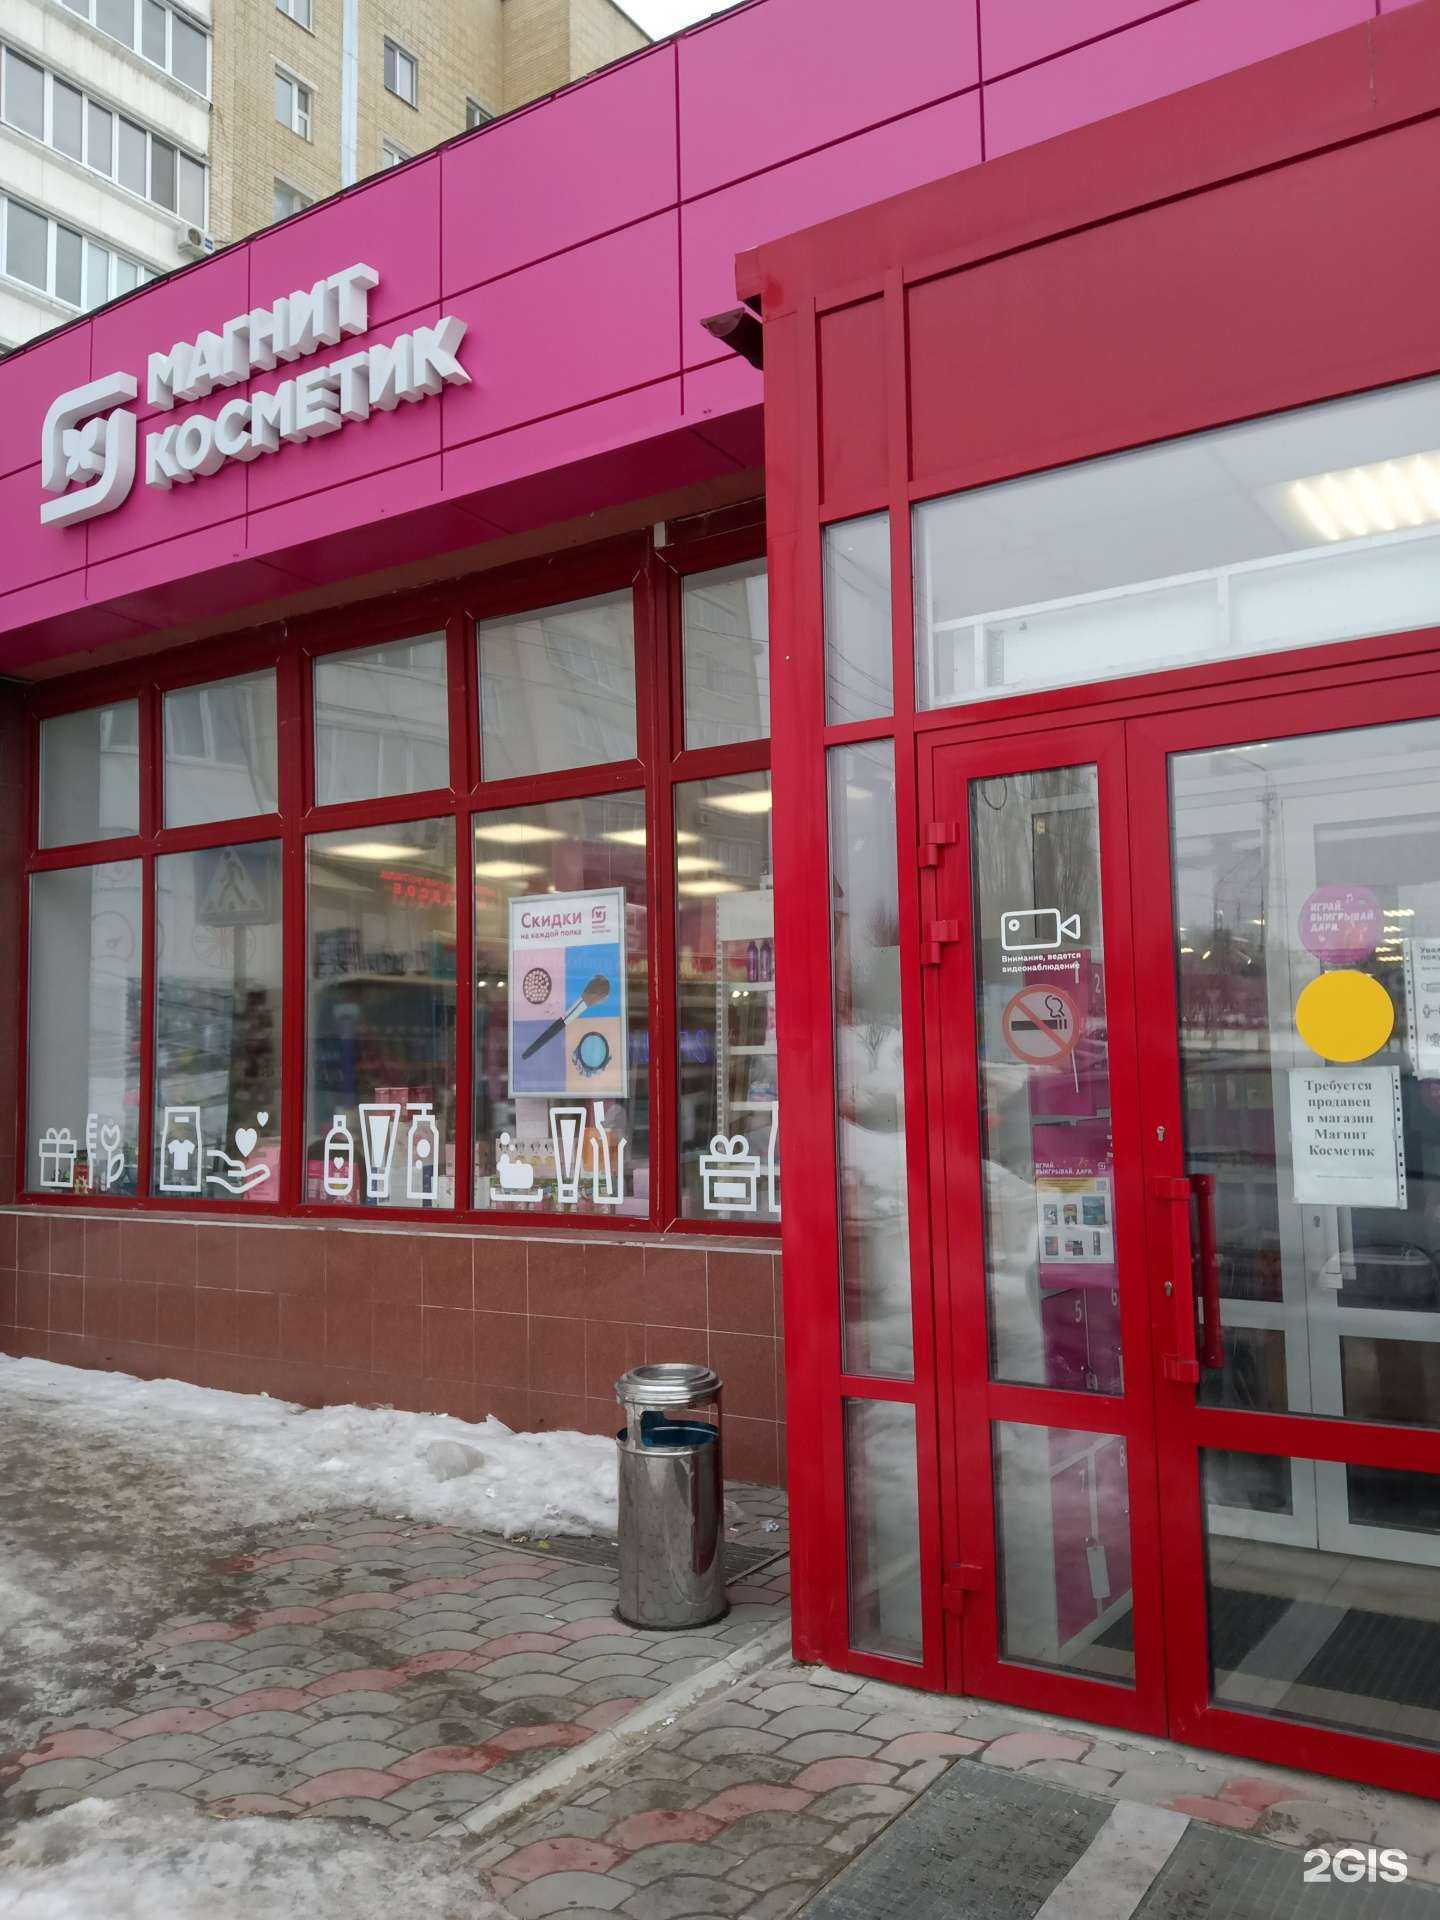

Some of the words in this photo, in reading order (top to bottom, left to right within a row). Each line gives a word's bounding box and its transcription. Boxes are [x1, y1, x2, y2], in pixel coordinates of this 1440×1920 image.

[146, 262, 380, 411] МАГНИТ
[144, 315, 472, 489] КОСМЕТИК
[521, 912, 582, 928] Скидки
[1001, 954, 1046, 963] Внимание,
[1047, 952, 1081, 961] ведется
[1002, 963, 1080, 973] видеонаблюдение
[1304, 1080, 1373, 1094] Требуется
[1307, 1115, 1314, 1123] в
[1319, 1114, 1374, 1124] магазин
[1314, 1128, 1368, 1140] Магнит
[1309, 1144, 1375, 1157] Косметик
[1075, 1300, 1082, 1322] 5
